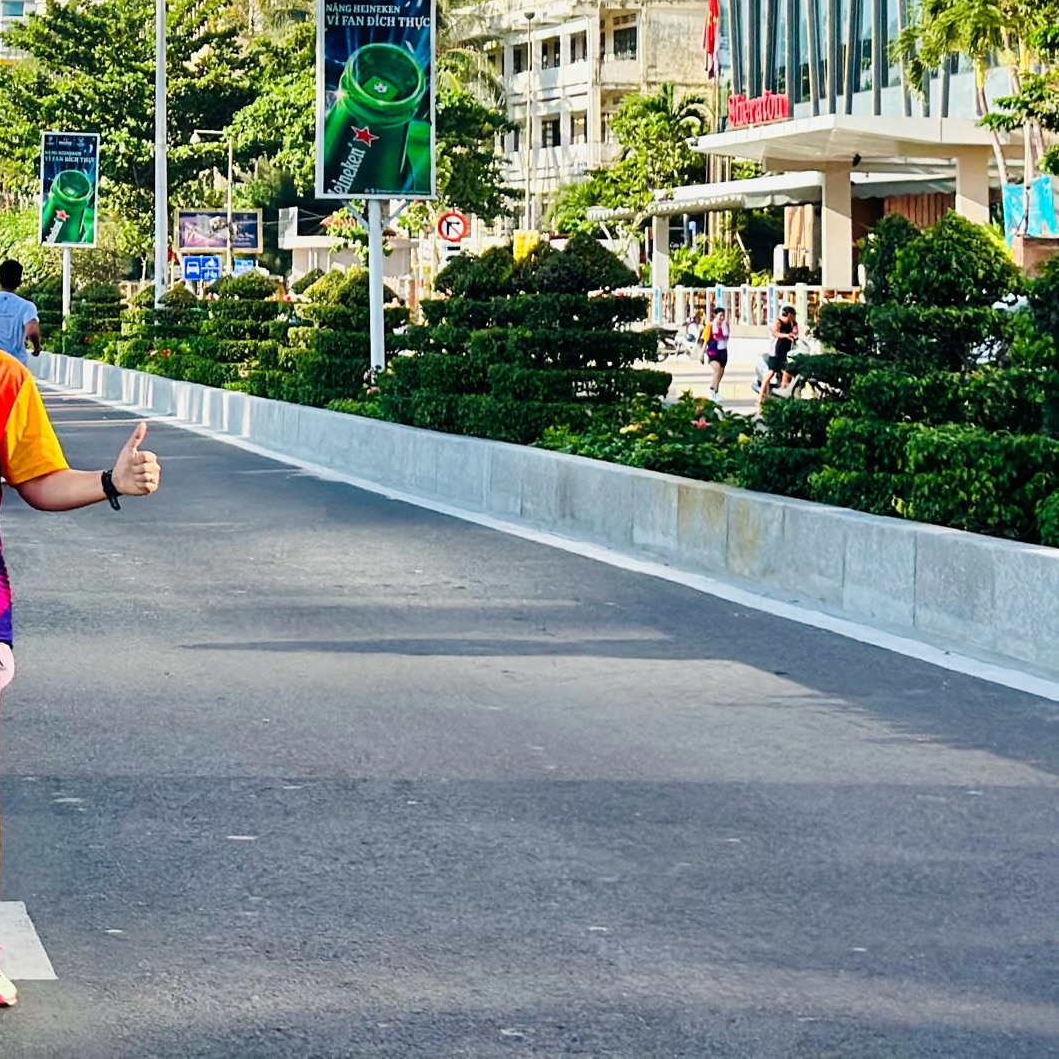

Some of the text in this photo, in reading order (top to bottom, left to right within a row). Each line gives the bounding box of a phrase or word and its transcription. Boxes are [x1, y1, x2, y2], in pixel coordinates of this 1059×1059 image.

[326, 12, 430, 30] VÌ FAN ĐÍCH THỰC
[353, 4, 400, 14] HEINEKEN
[728, 89, 788, 127] Sheraton
[327, 145, 366, 194] eineken
